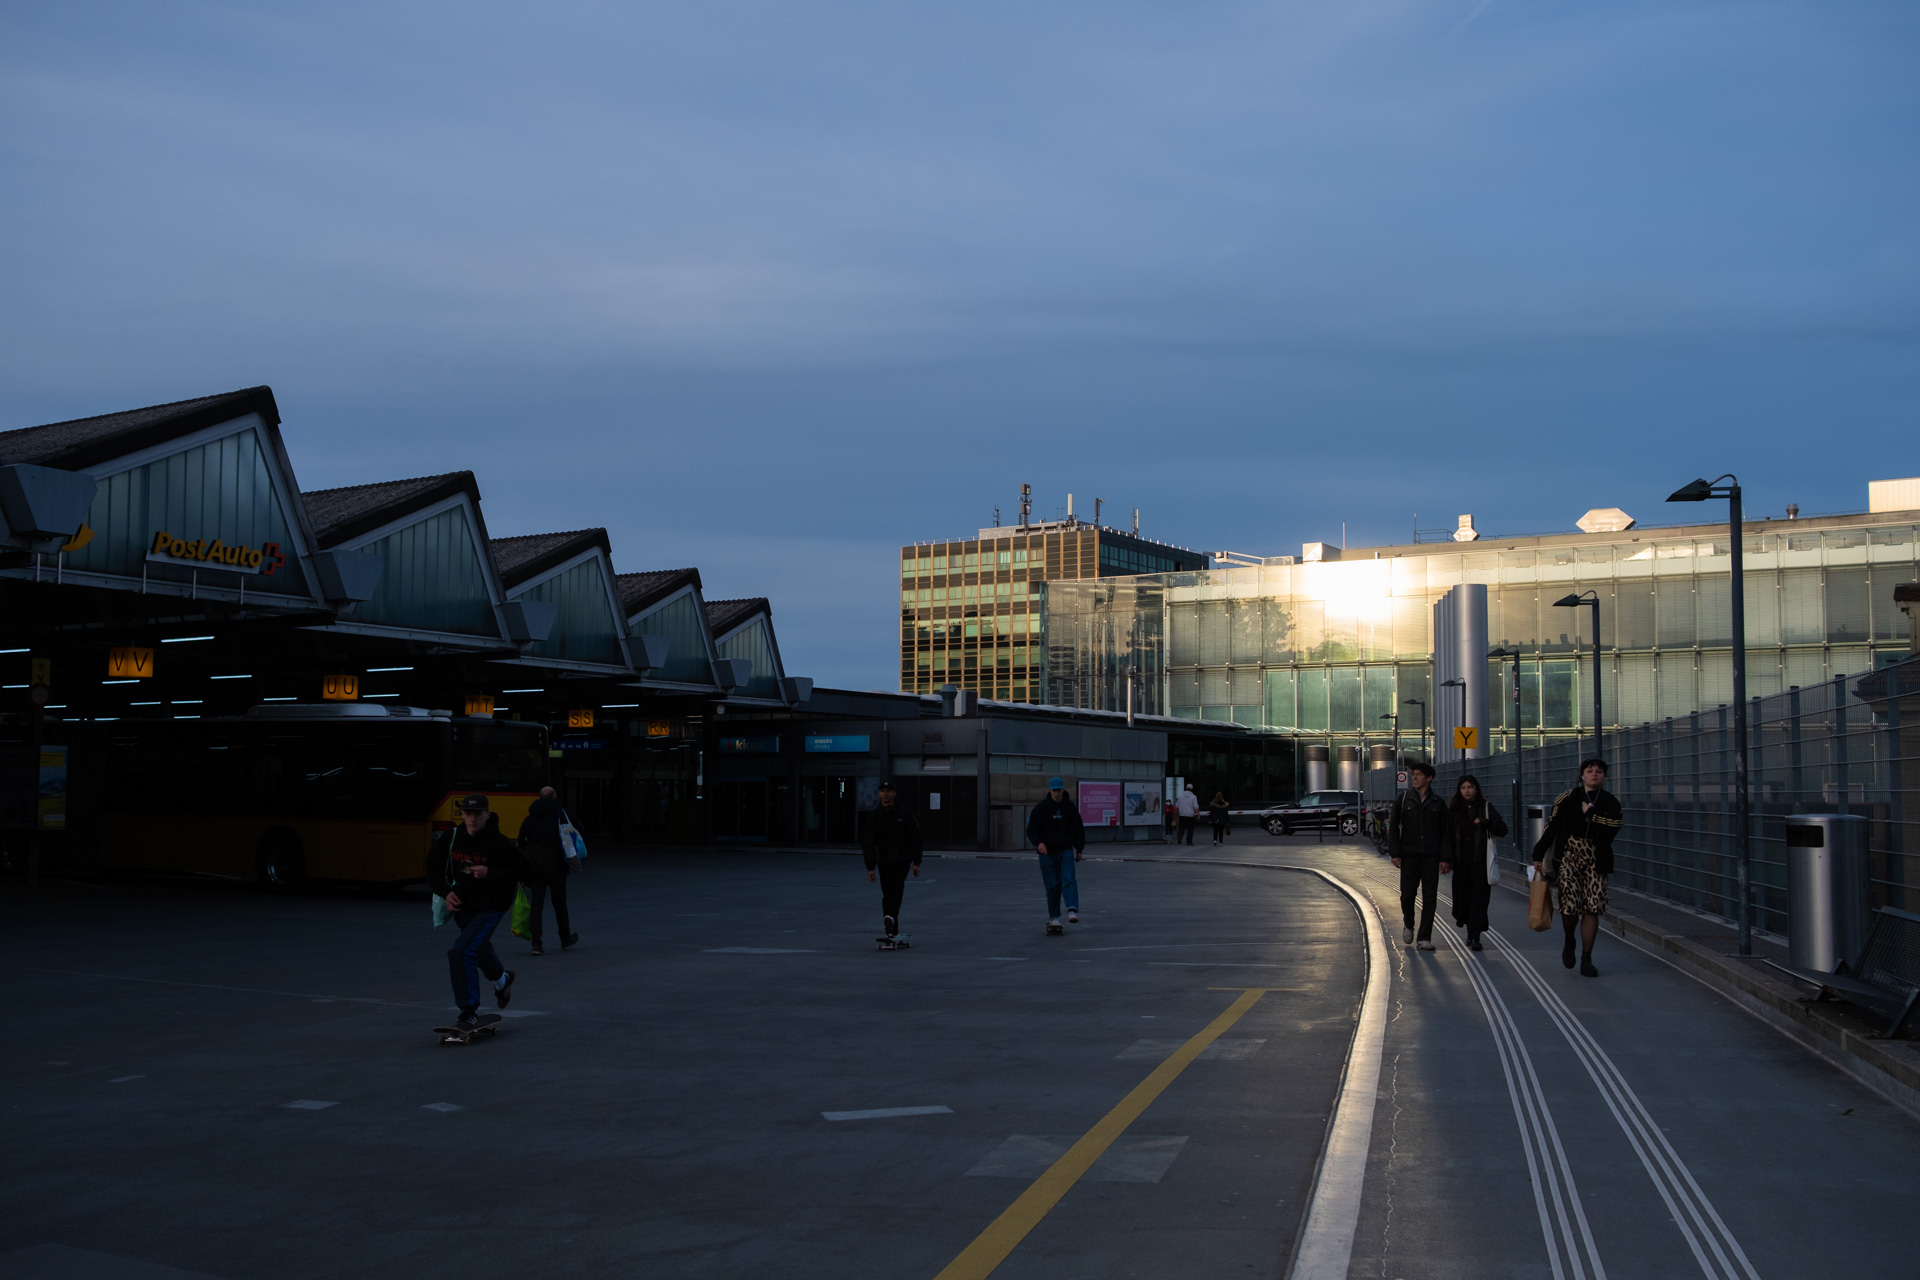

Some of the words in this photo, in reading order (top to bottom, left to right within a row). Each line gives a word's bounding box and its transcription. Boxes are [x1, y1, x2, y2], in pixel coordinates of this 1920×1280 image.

[153, 532, 263, 567] PostAuto
[113, 651, 125, 672] V
[133, 651, 149, 672] V
[327, 678, 337, 695] U
[344, 678, 354, 695] U
[468, 698, 477, 713] T
[482, 698, 491, 713] T
[571, 712, 580, 726] S
[583, 712, 592, 725] S
[649, 721, 658, 734] R
[660, 721, 669, 734] R
[1460, 731, 1473, 745] Y
